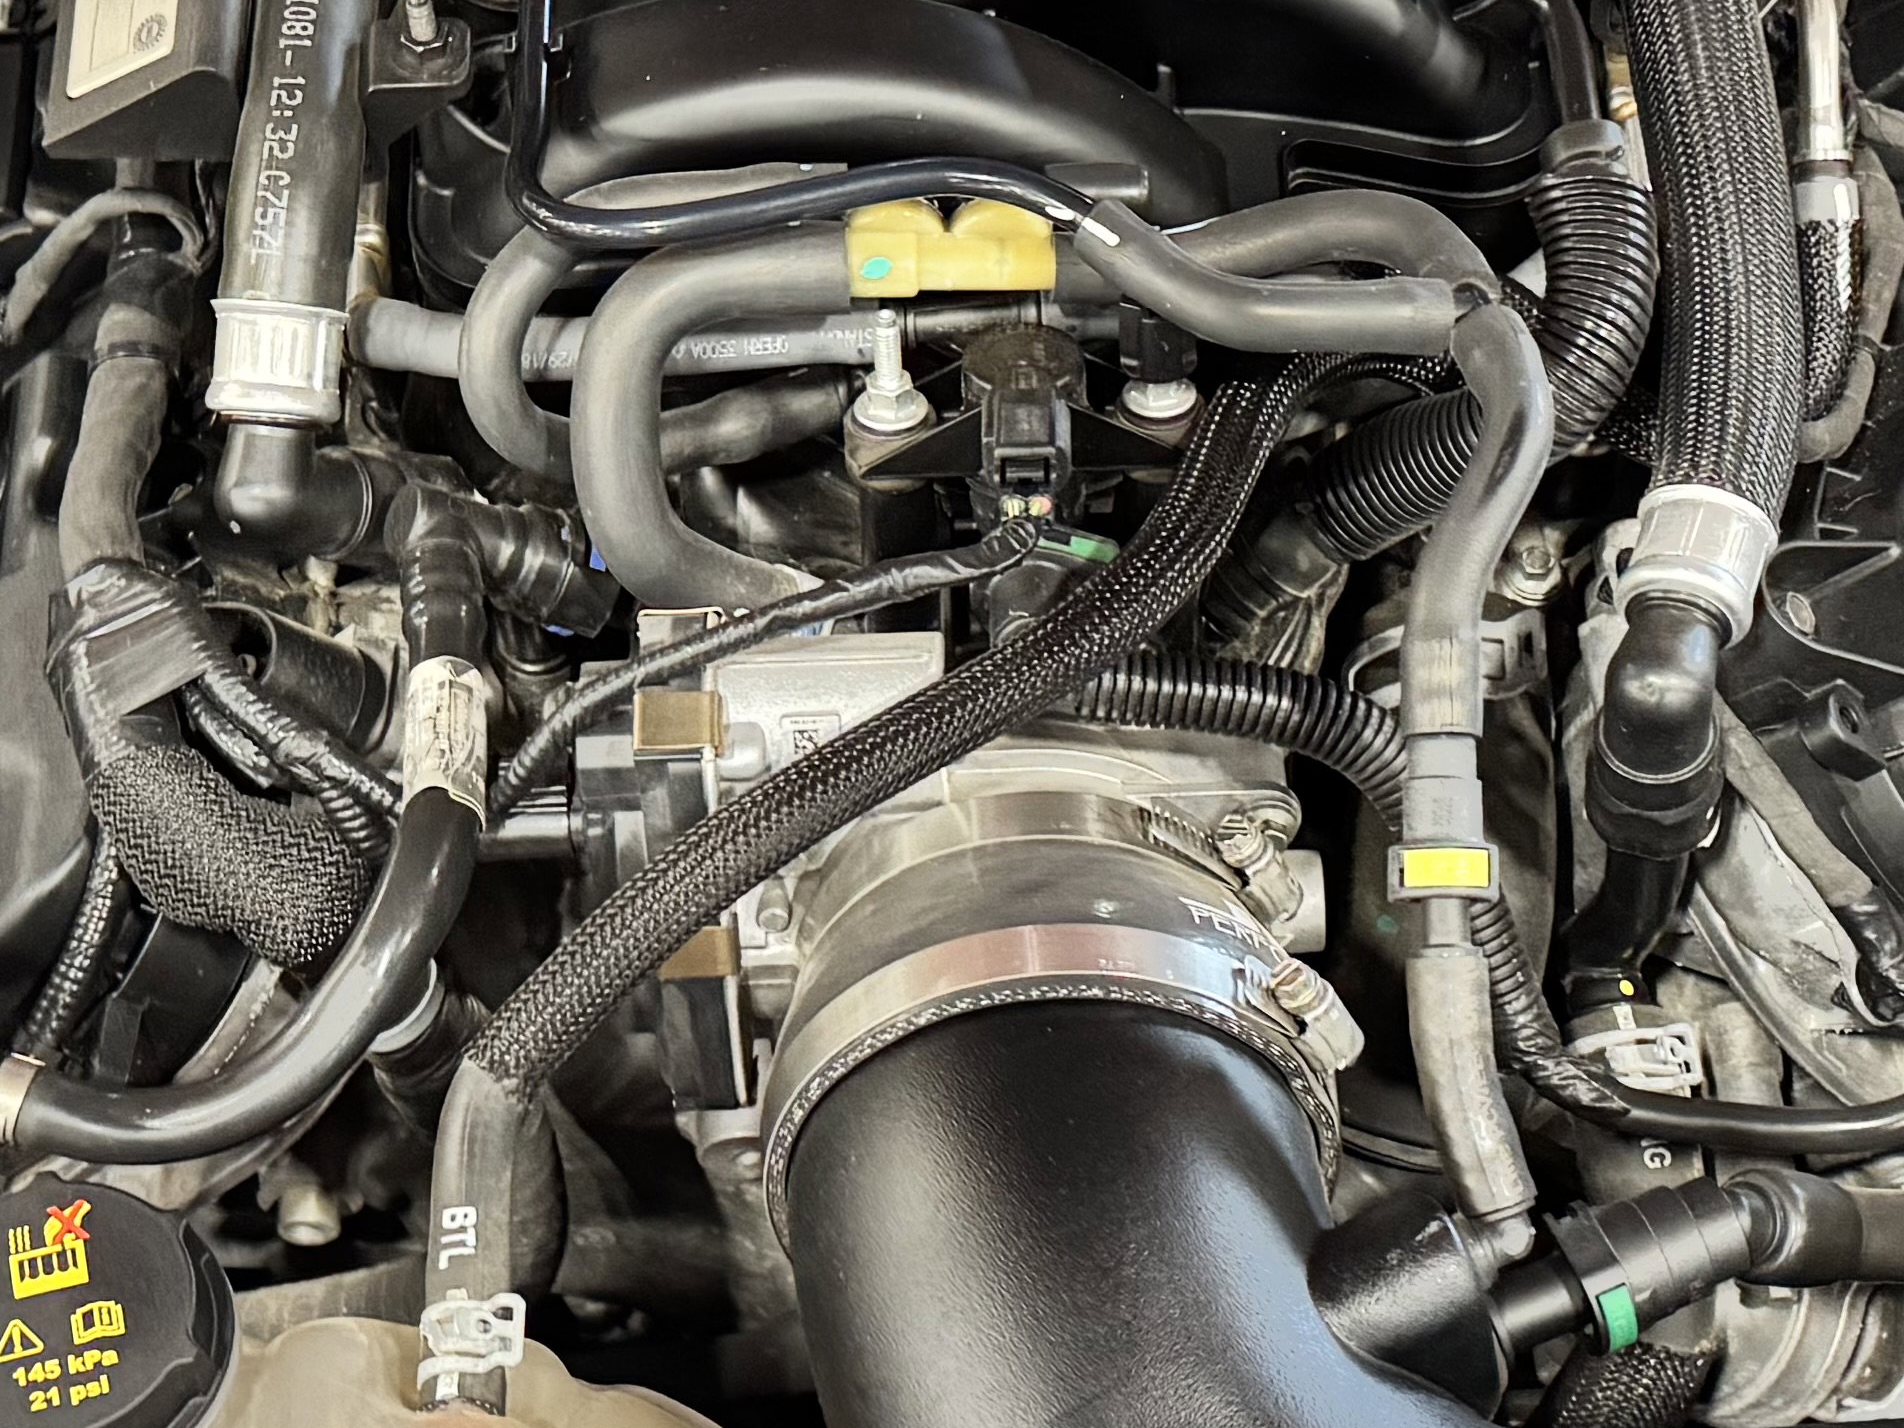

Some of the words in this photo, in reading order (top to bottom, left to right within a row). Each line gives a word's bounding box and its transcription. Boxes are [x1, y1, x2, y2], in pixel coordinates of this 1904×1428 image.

[437, 1205, 478, 1271] BTL
[11, 1358, 62, 1388] 145
[66, 1348, 120, 1375] kPa
[28, 1385, 61, 1413] 21
[68, 1373, 112, 1406] psi
